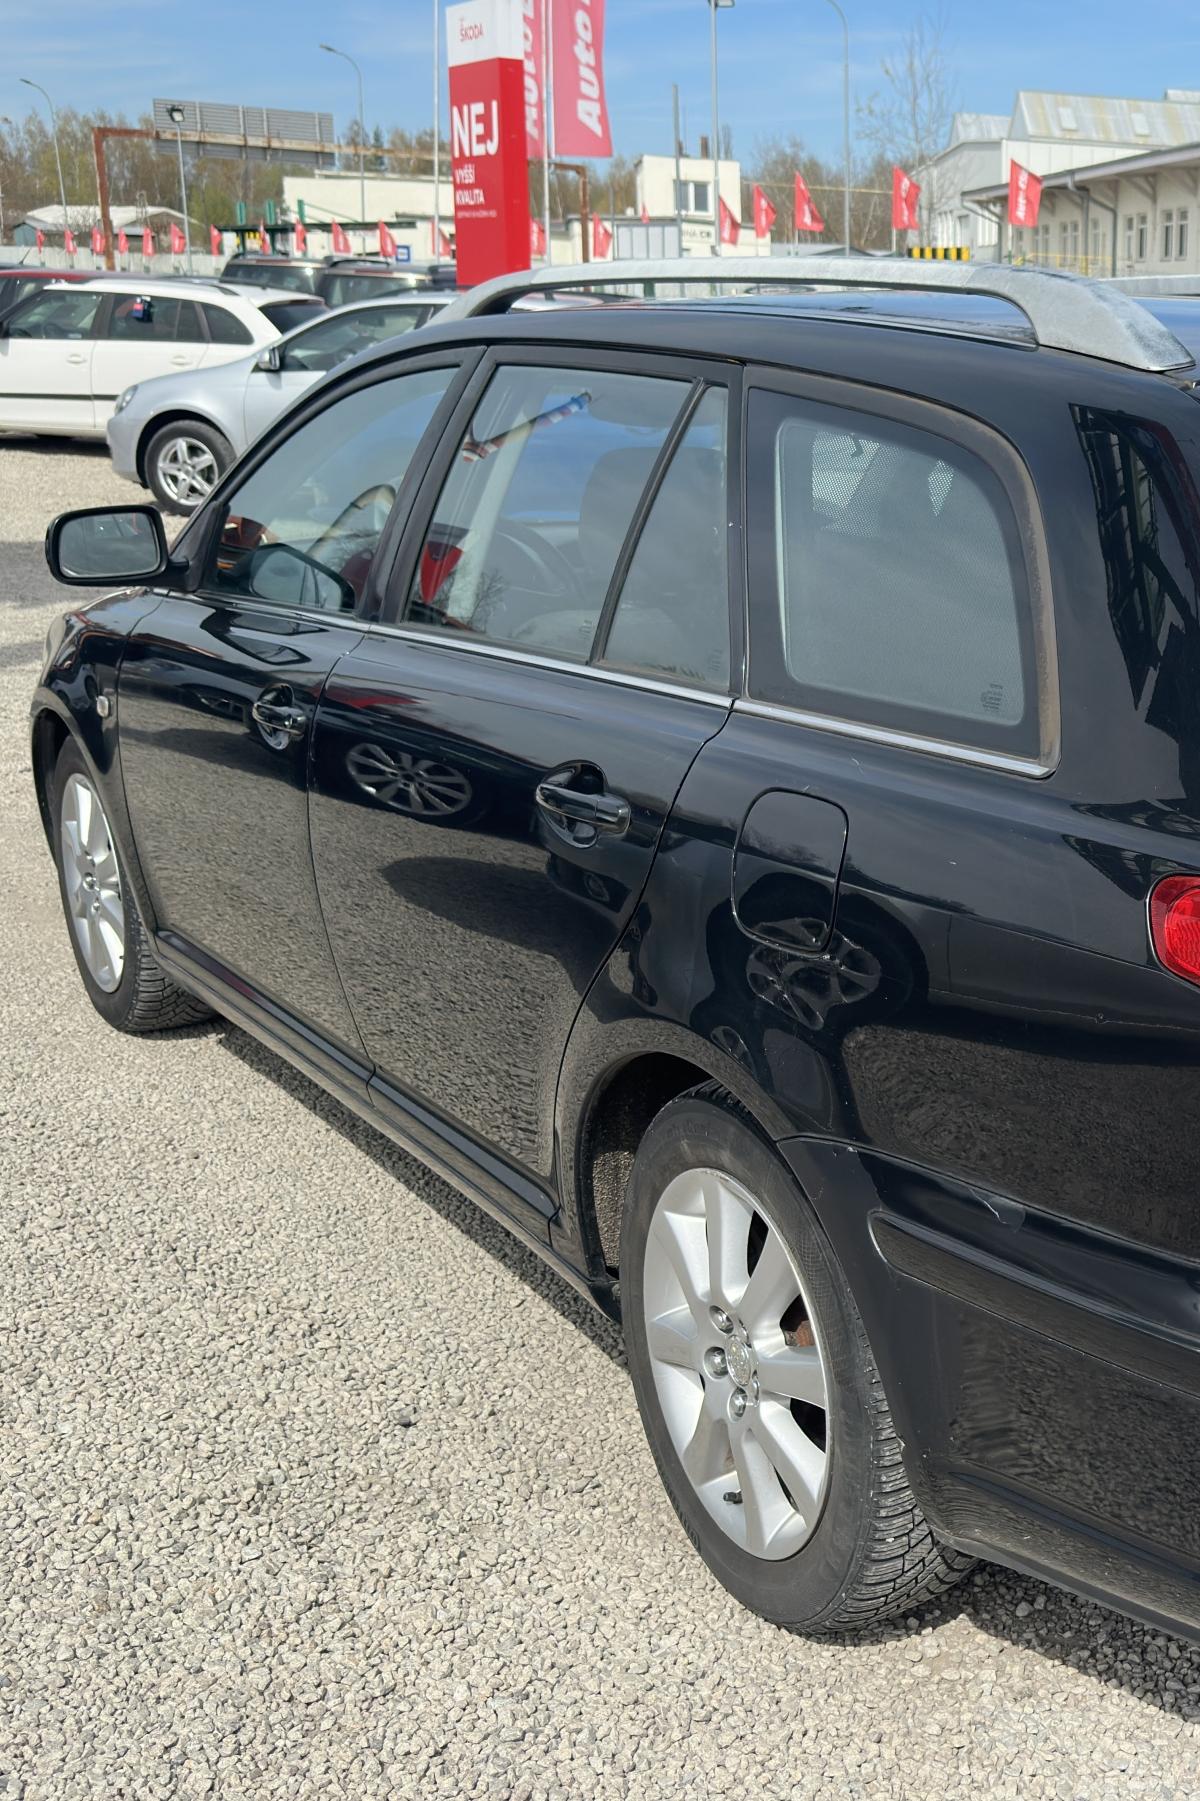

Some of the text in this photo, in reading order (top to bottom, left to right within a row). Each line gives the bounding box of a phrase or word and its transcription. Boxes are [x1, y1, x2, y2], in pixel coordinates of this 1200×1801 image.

[460, 23, 484, 42] ŠKODA
[574, 8, 603, 139] Auto
[451, 99, 499, 159] NEJ
[455, 188, 486, 206] KVALITA
